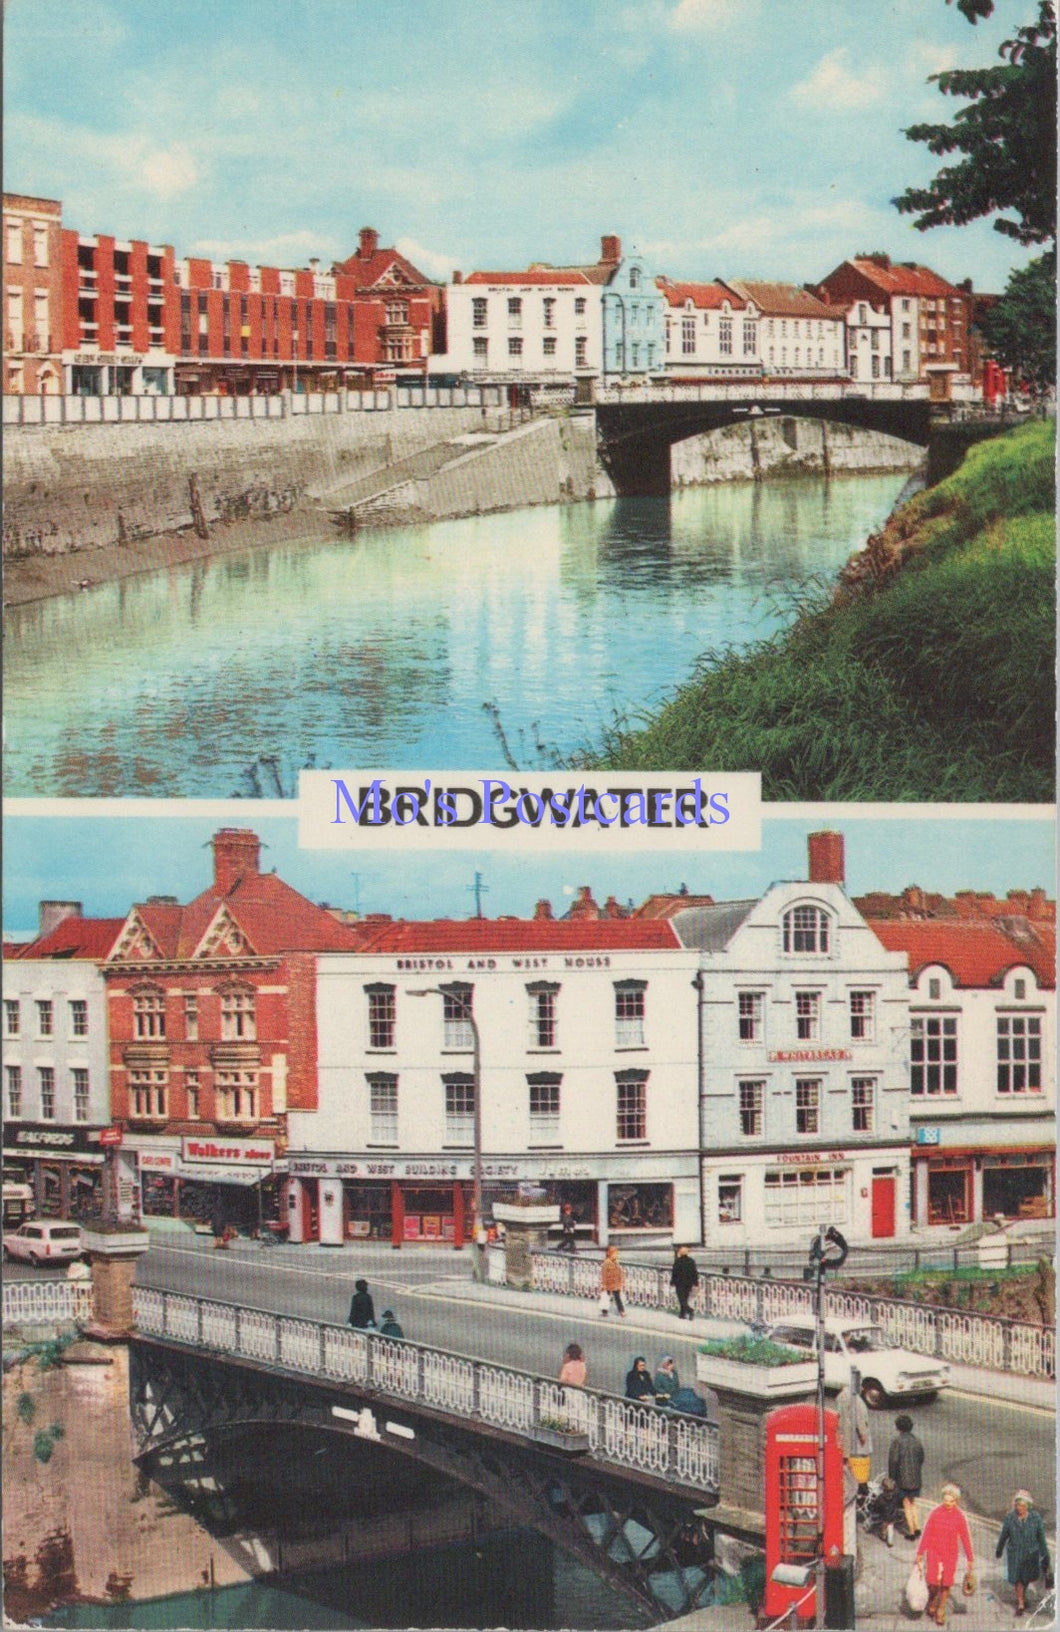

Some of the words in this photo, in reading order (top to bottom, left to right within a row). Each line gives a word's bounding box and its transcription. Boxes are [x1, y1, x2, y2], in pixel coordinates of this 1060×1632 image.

[357, 786, 710, 828] BRIDGWATER
[396, 960, 453, 969] BRISTOL
[467, 960, 497, 969] AND
[512, 958, 548, 968] WEST
[564, 957, 611, 967] HOUSE
[187, 1142, 241, 1158] Walkers
[776, 1155, 821, 1163] FOUNTAIN
[294, 1163, 328, 1173] BRISTOL
[336, 1164, 358, 1174] AND
[367, 1164, 395, 1174] WEST
[405, 1165, 457, 1175] BUILDING
